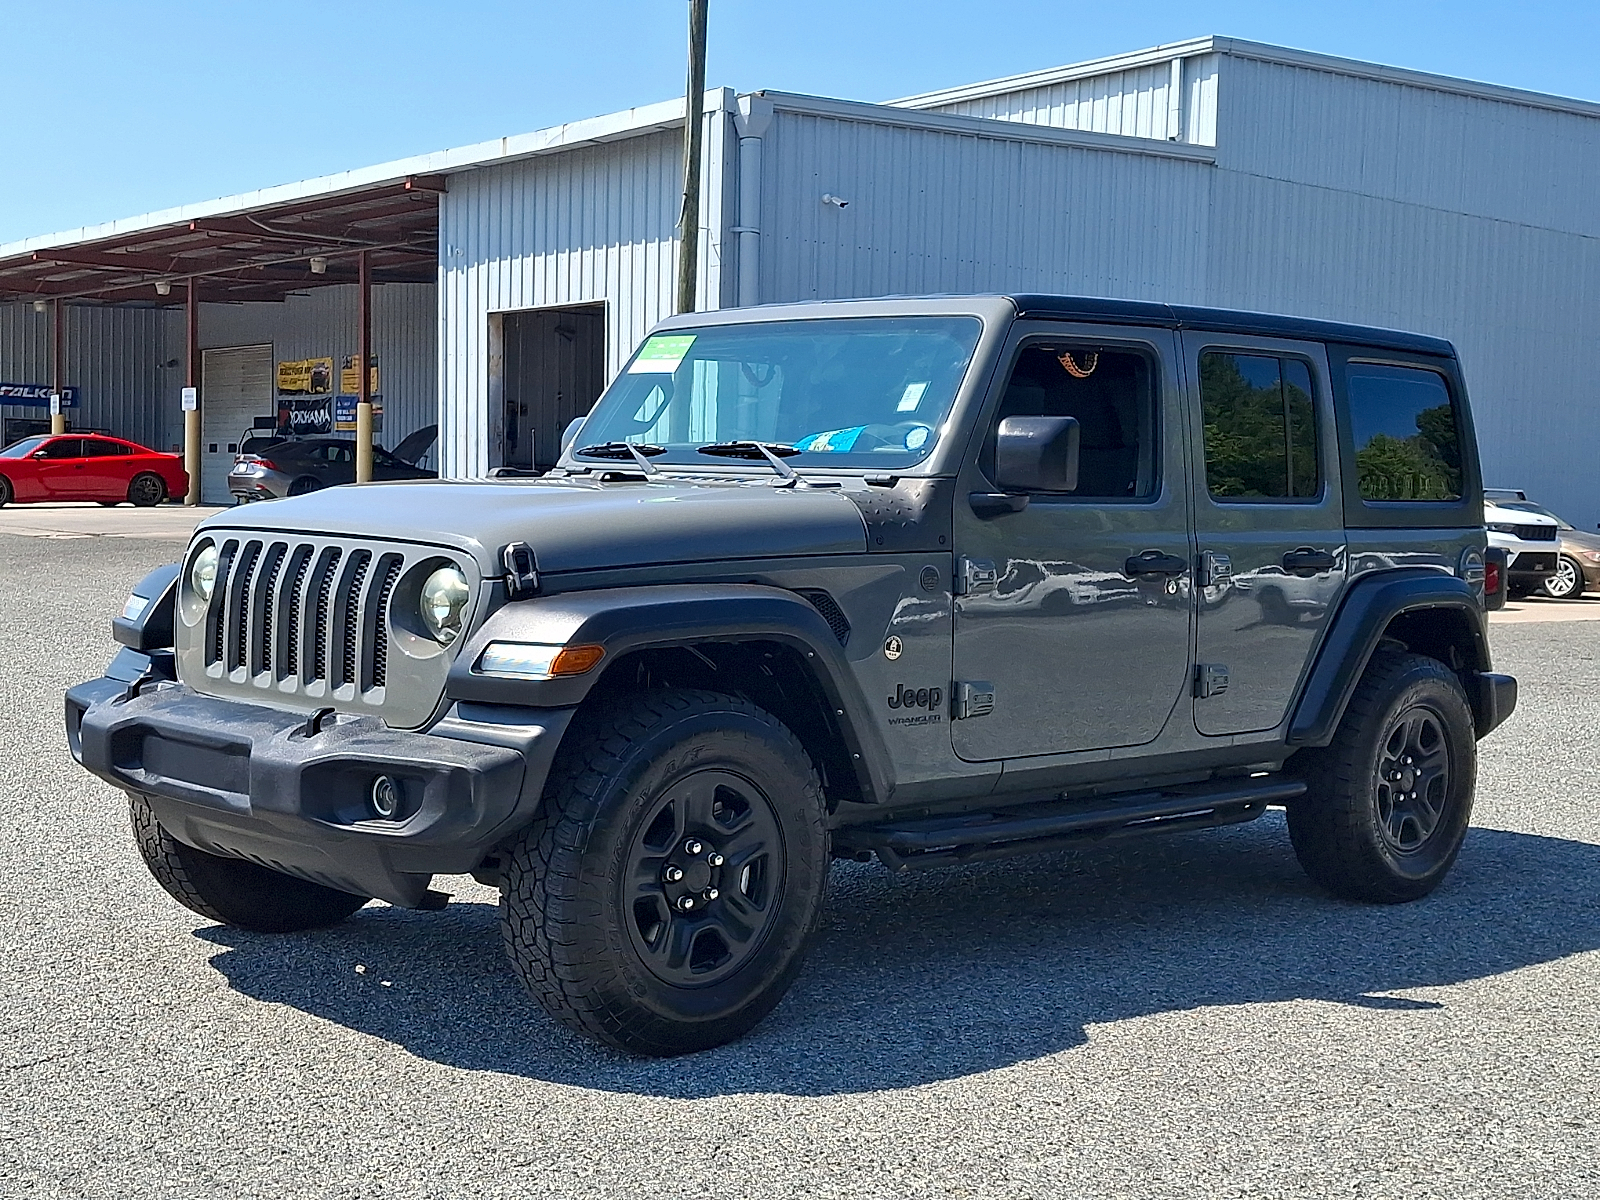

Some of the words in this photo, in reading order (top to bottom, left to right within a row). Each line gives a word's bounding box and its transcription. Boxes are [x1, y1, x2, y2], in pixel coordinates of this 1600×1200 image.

[289, 407, 331, 424] YOKOHAMA
[888, 684, 942, 711] Jeep
[888, 714, 941, 725] WRANGLER
